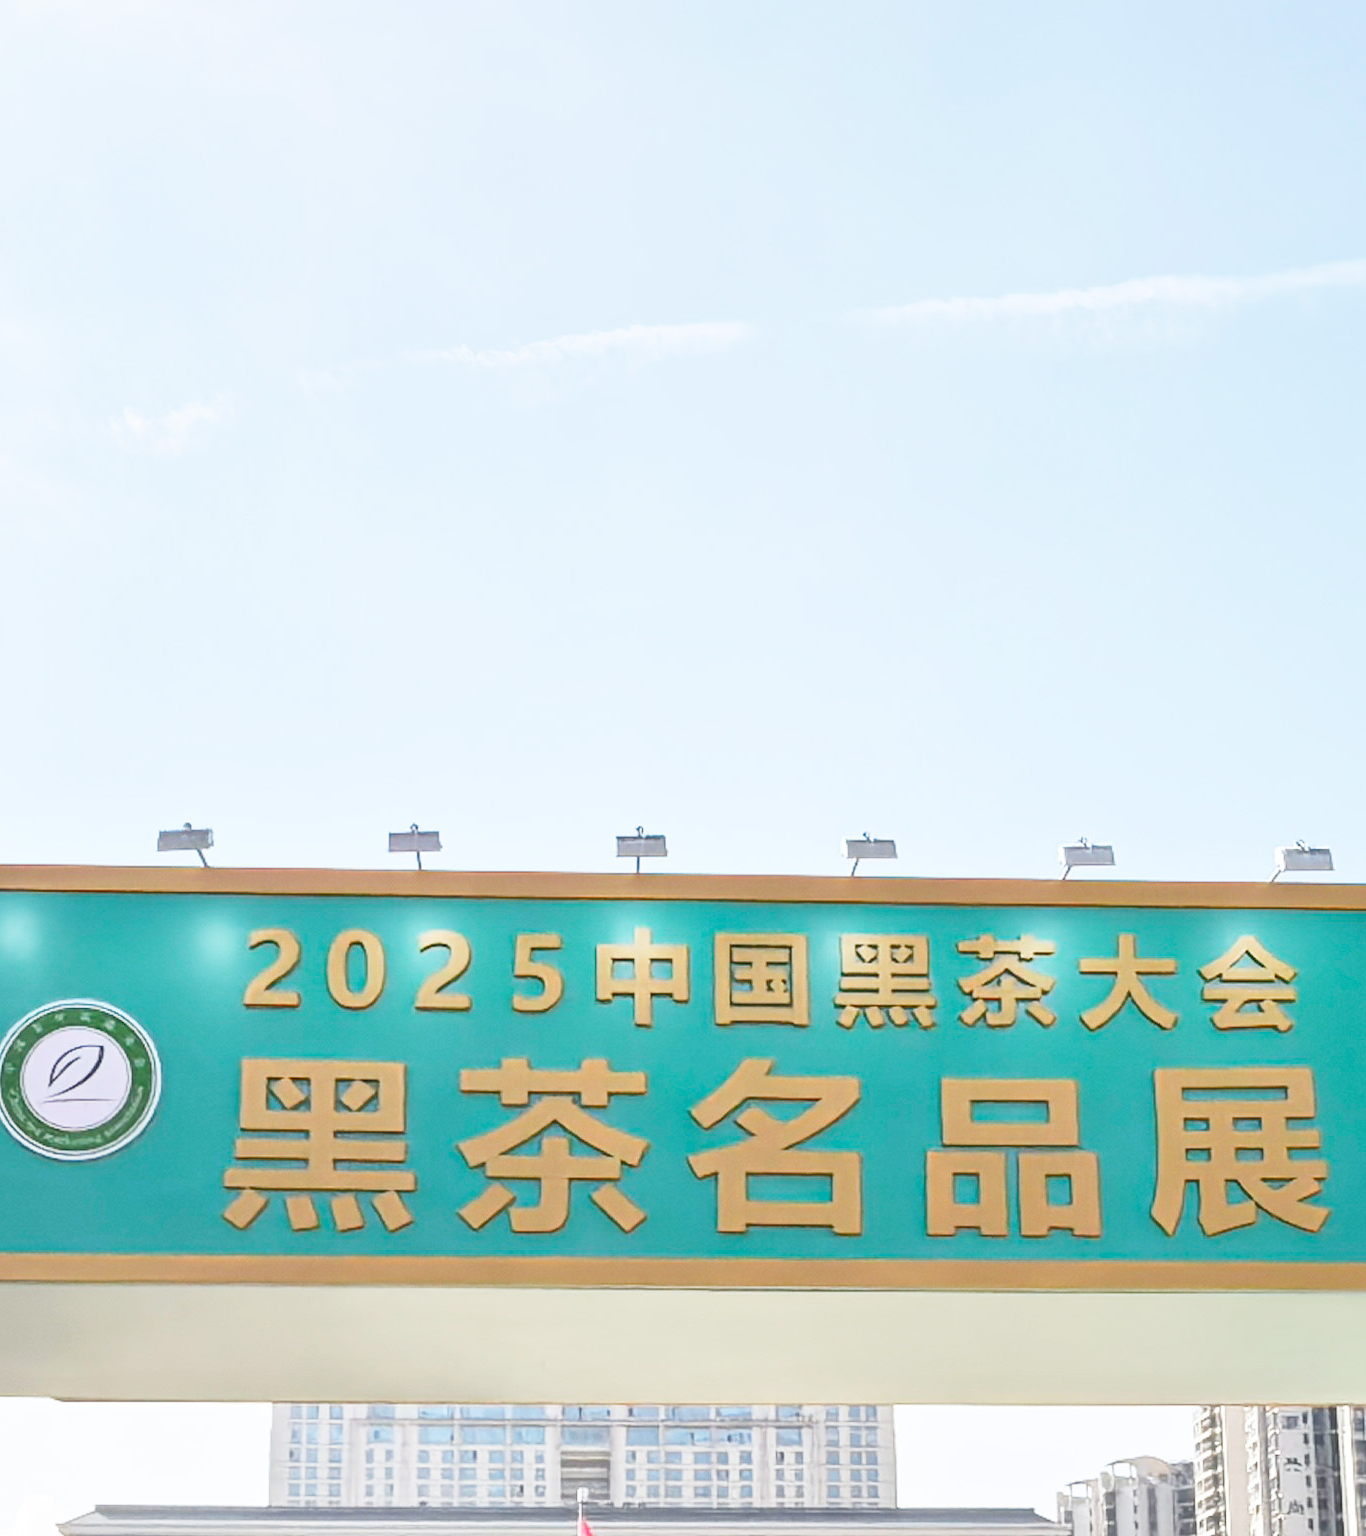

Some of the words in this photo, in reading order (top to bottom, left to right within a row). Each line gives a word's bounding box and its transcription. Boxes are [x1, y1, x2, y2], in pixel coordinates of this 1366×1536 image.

[244, 926, 1299, 1032] 2025中国黑茶大会
[222, 1056, 1331, 1238] 黑茶名品展
